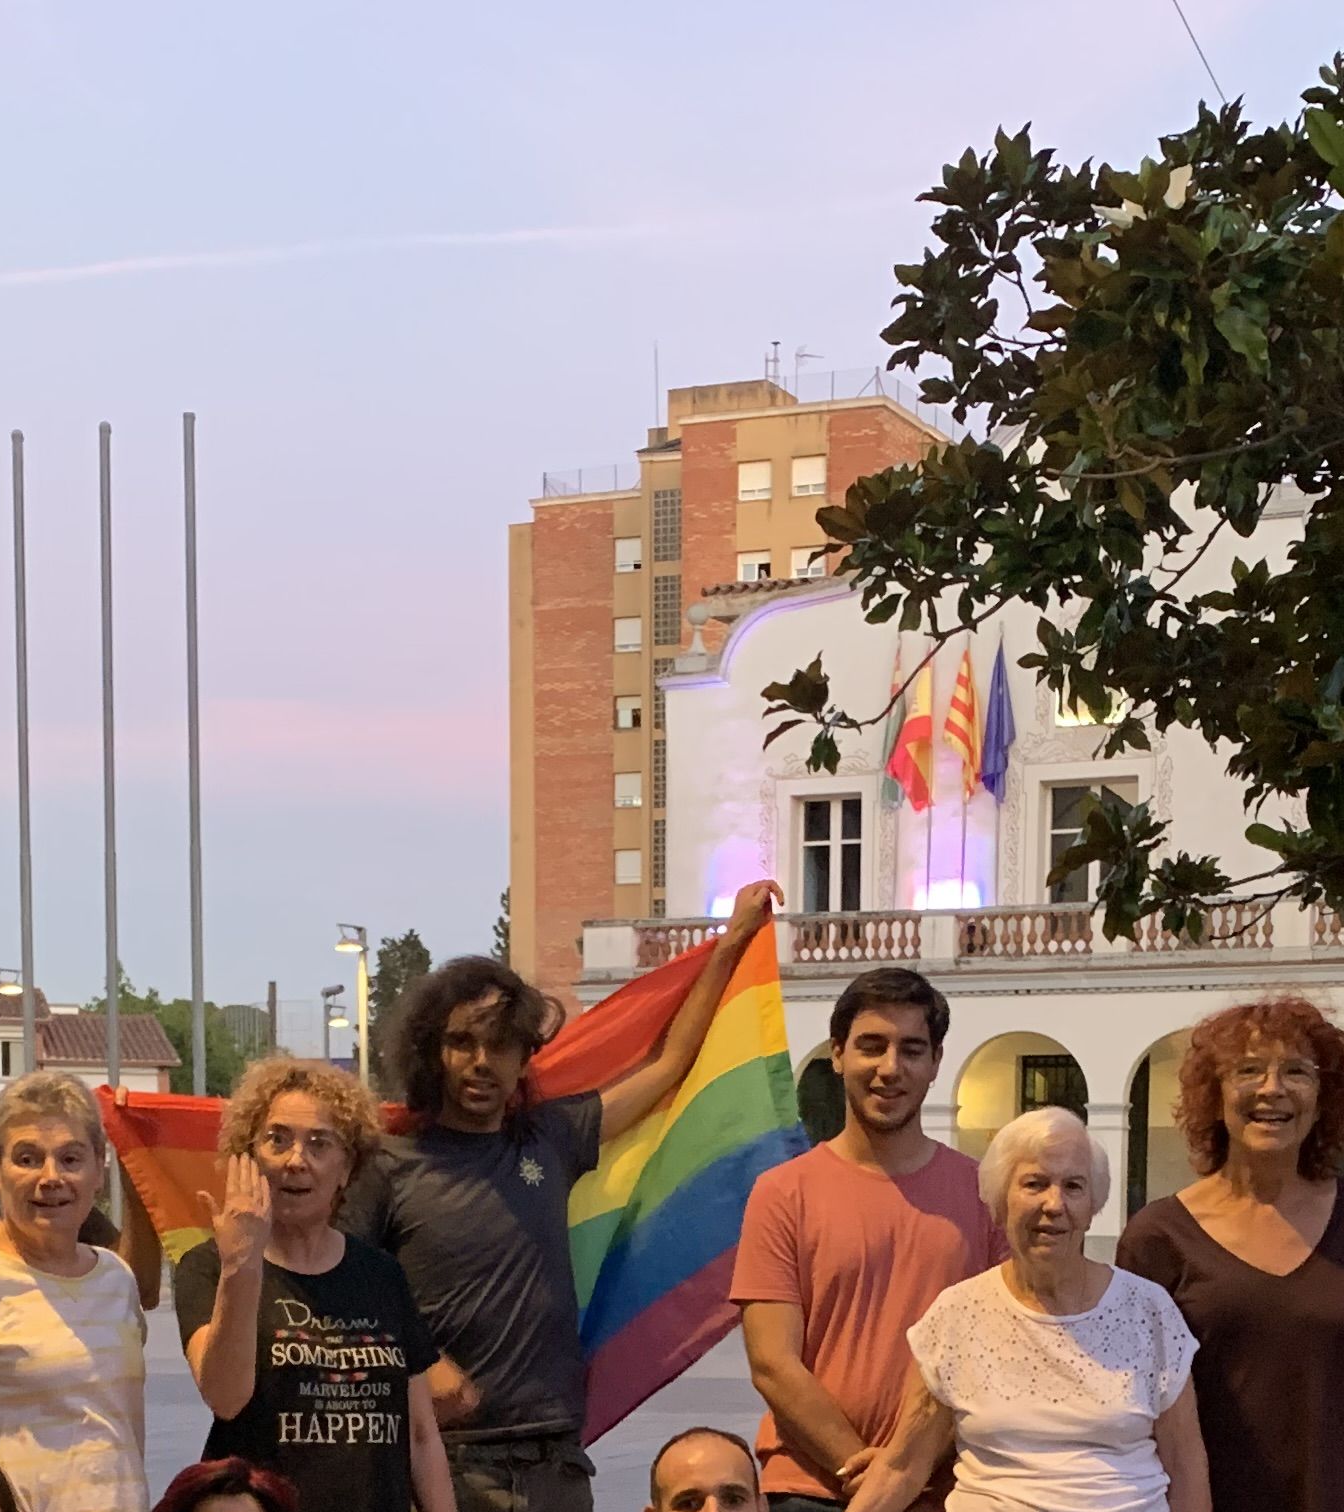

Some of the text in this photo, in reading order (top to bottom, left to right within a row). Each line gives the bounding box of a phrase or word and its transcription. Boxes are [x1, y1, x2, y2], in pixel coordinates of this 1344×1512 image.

[274, 1298, 379, 1331] Dream
[271, 1342, 406, 1370] SOMETHING
[299, 1382, 392, 1397] MARVELOUS
[325, 1400, 360, 1411] ABOUT
[361, 1399, 377, 1410] TO
[278, 1411, 402, 1444] HAPPEN
